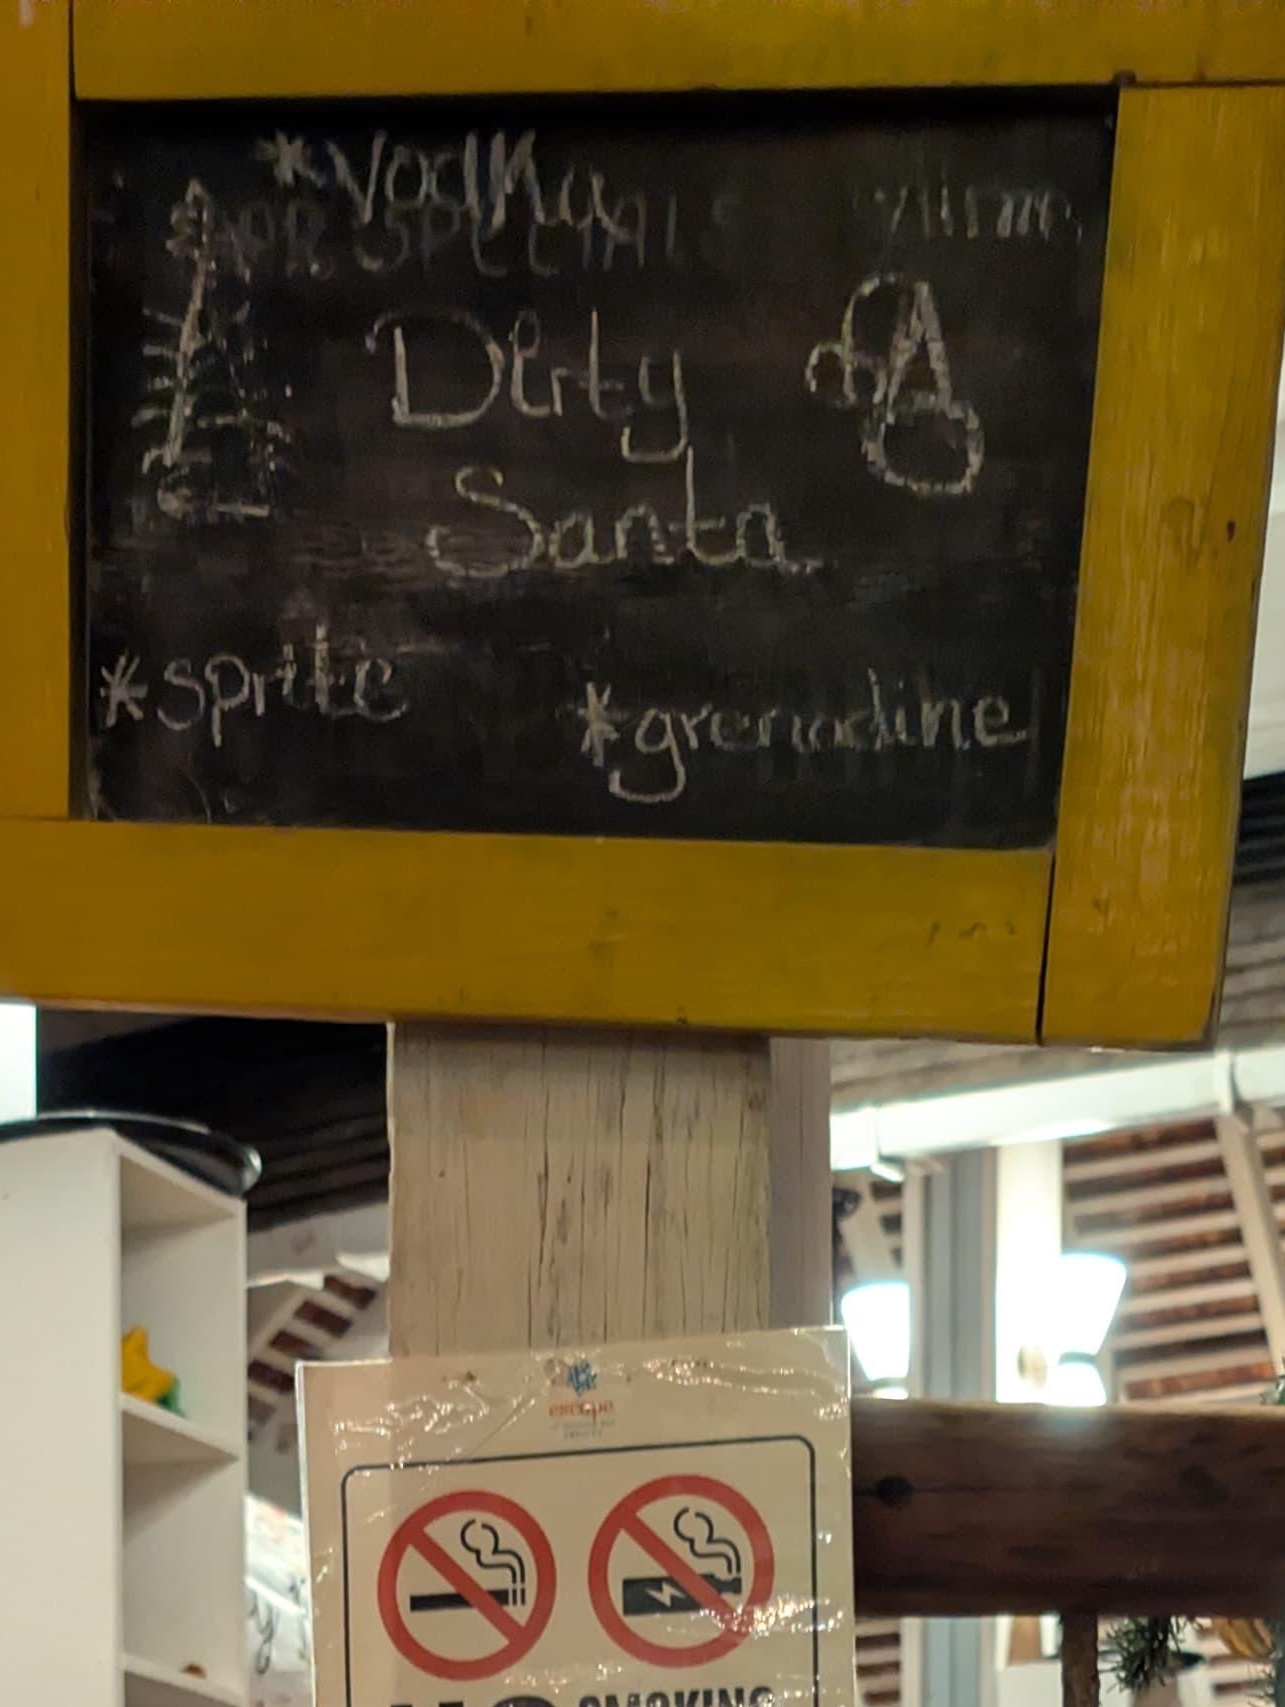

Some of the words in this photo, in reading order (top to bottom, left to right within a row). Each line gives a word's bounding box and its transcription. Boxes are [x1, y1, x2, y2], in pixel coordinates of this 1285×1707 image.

[365, 308, 689, 463] Dirty
[423, 446, 821, 578] Santa
[609, 667, 1028, 802] grenadine
